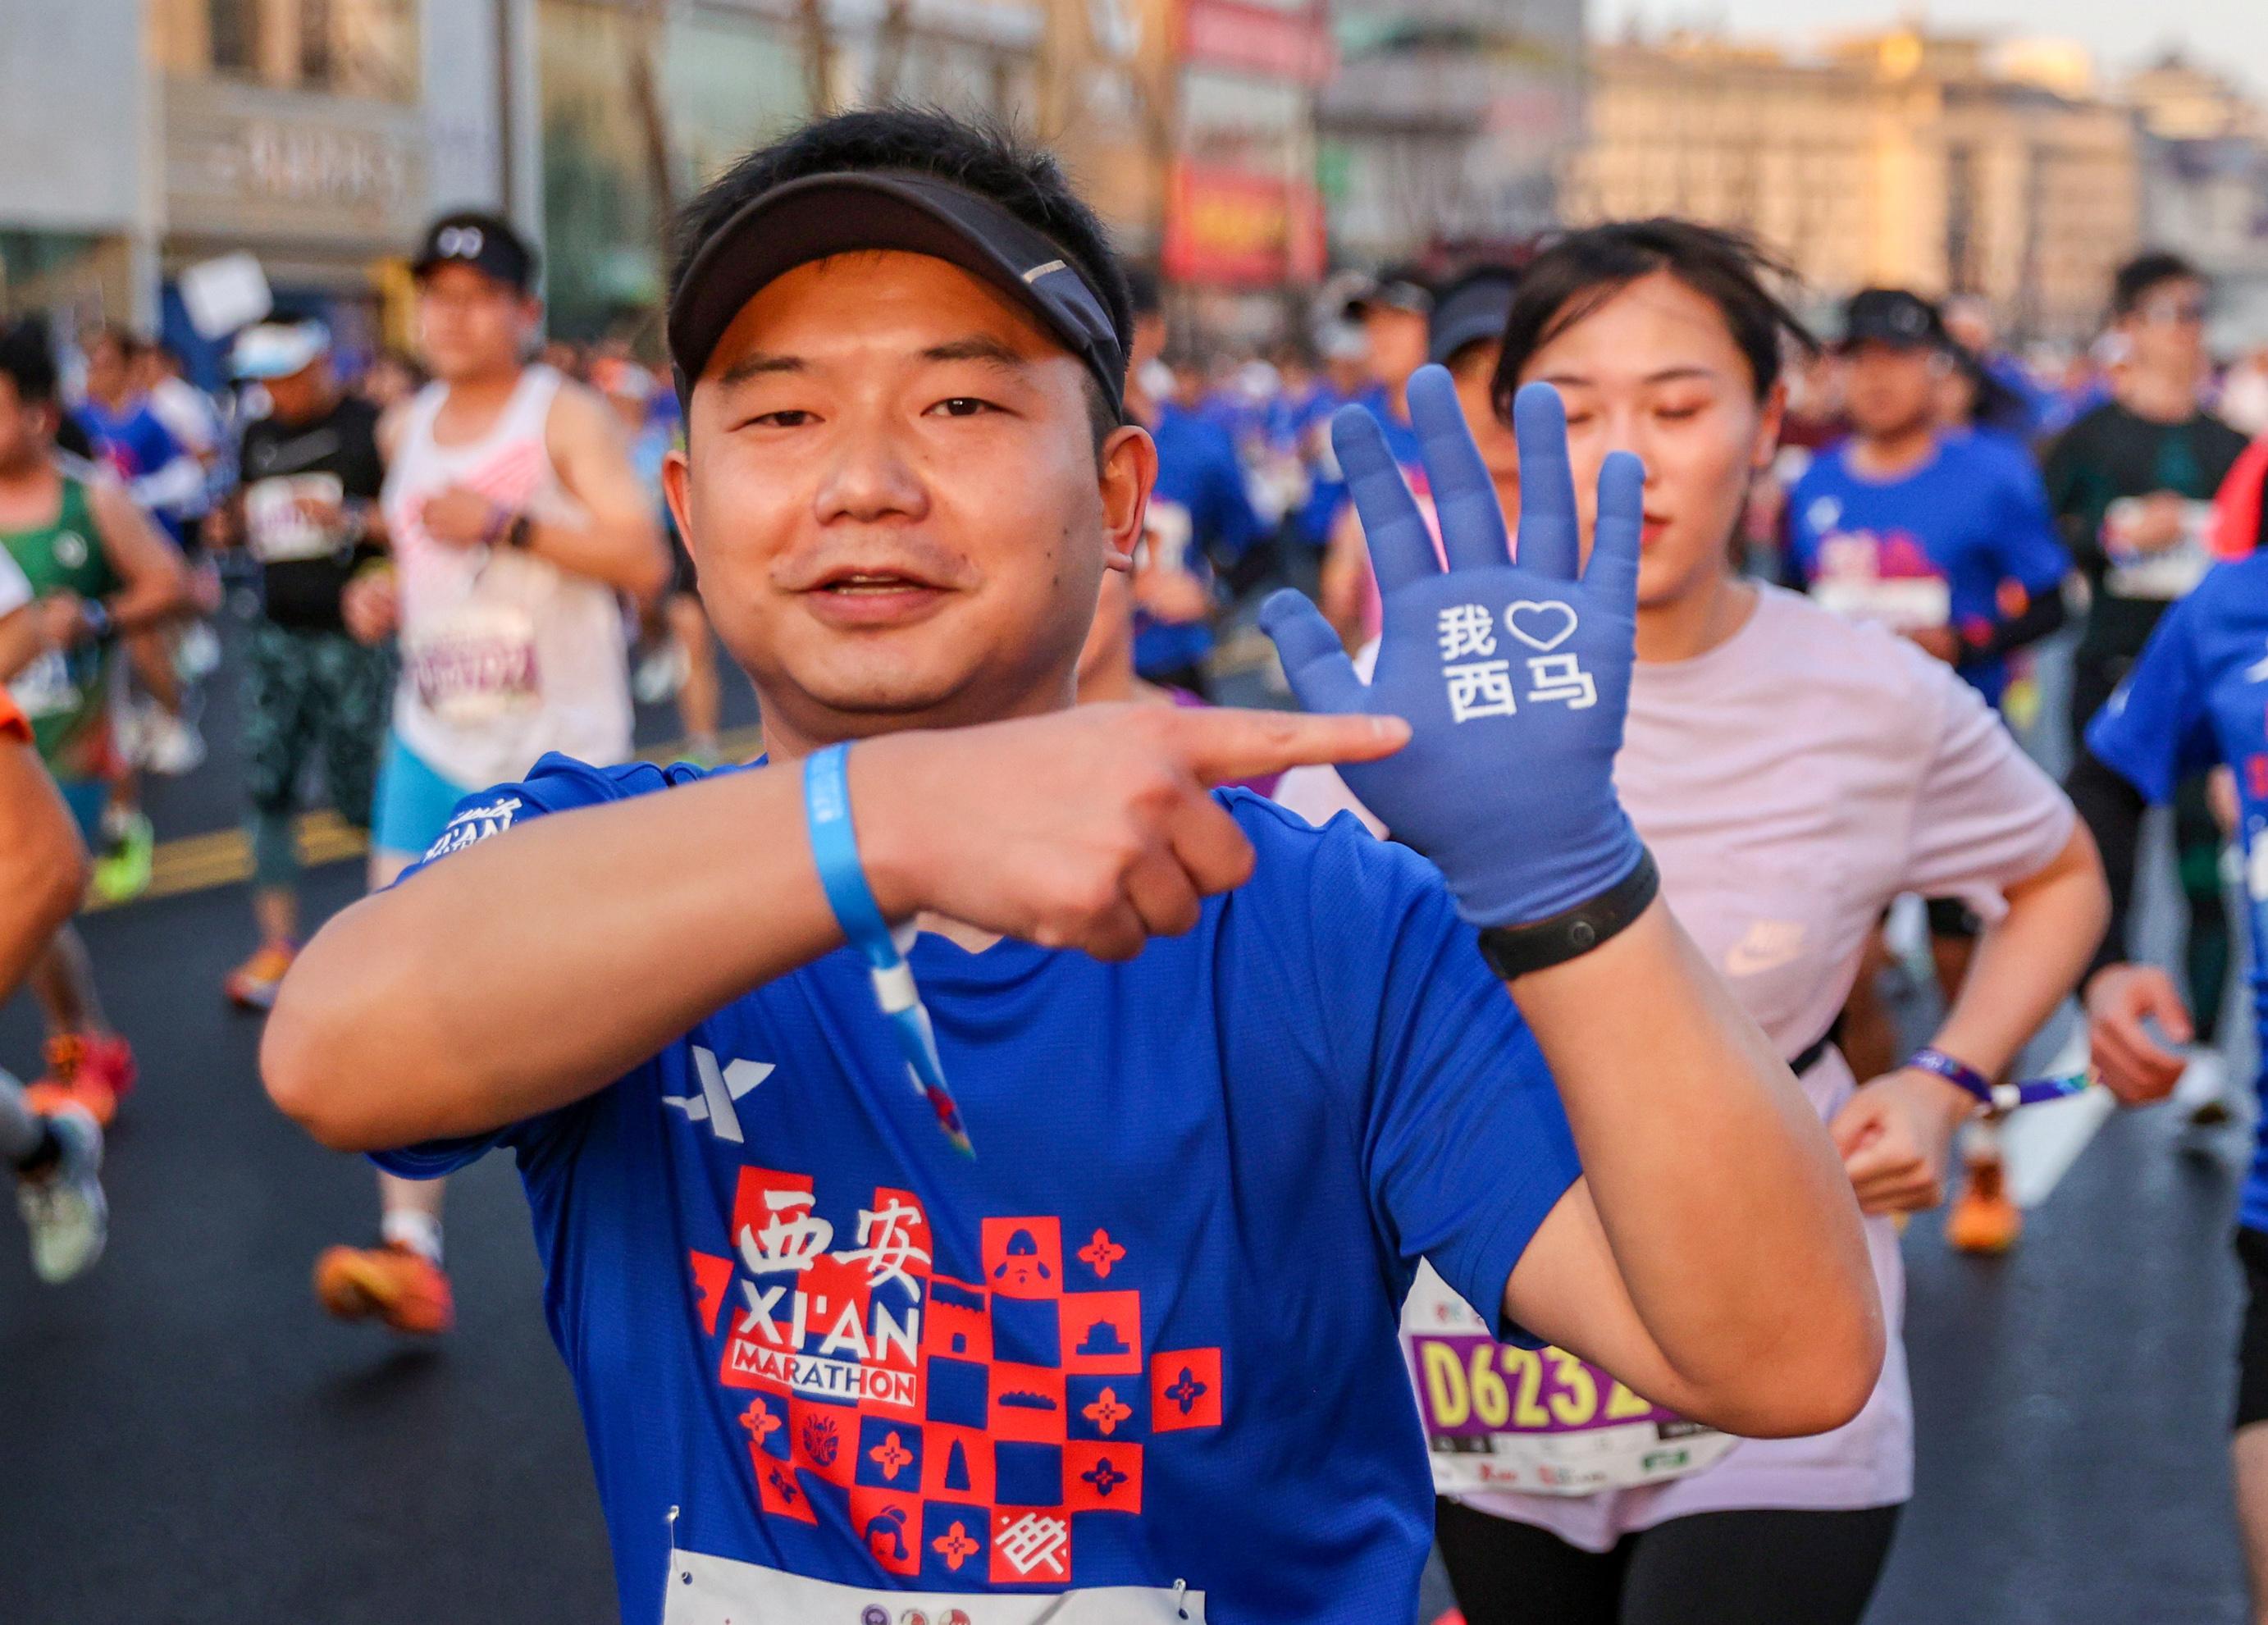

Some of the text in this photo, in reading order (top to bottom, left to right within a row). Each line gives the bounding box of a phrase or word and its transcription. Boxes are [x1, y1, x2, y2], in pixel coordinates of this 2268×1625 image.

[1438, 603, 1498, 661] 我
[1442, 652, 1598, 723] 西马
[740, 1189, 932, 1303] 西安
[738, 1278, 920, 1367] XI'AN
[735, 1342, 915, 1405] MARATHON
